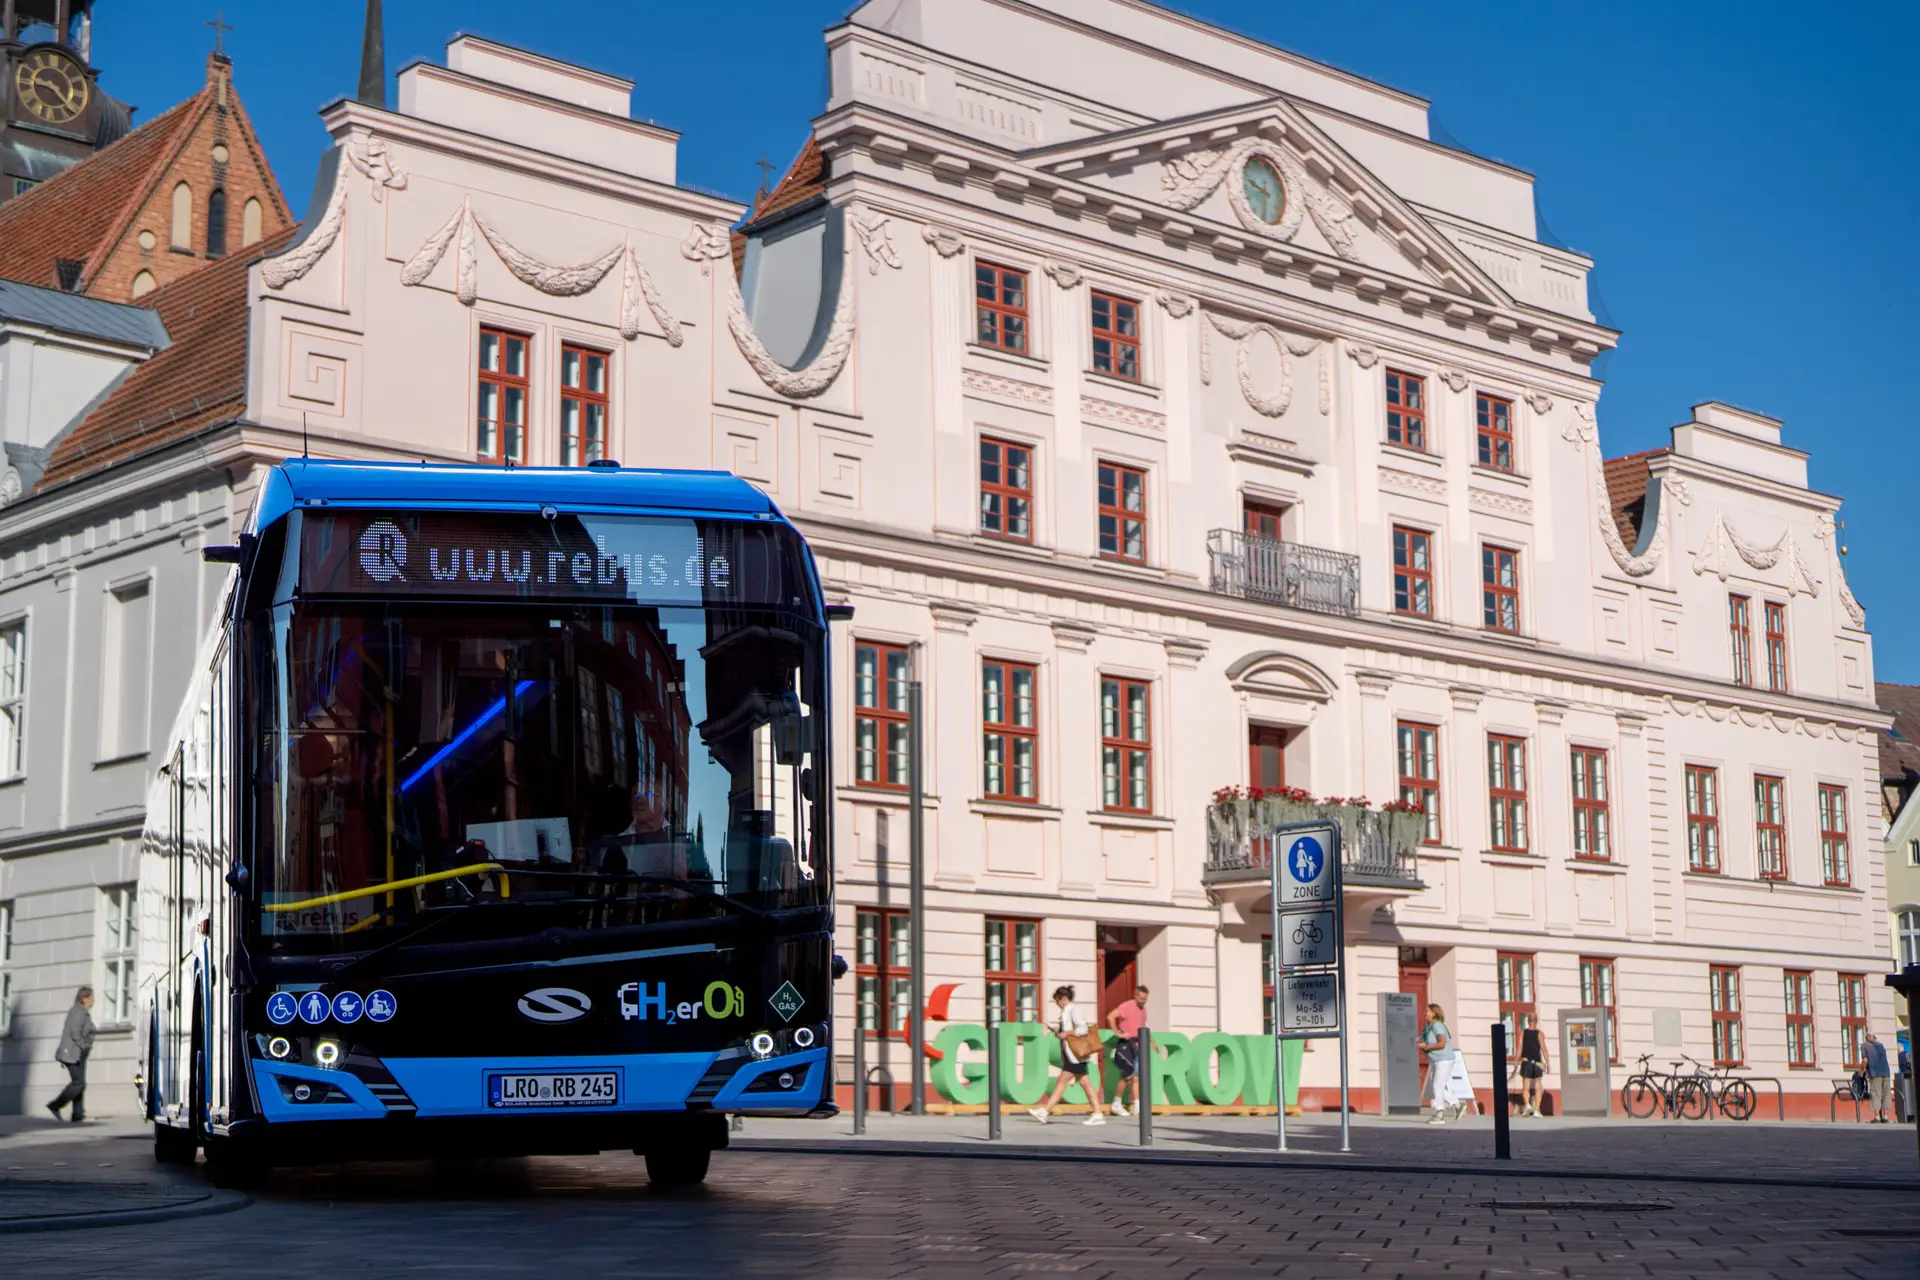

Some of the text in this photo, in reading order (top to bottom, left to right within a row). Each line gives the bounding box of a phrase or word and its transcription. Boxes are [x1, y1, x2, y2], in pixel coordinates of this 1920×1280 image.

[430, 535, 730, 587] www.rebus.de
[1293, 885, 1320, 898] ZONE
[1300, 948, 1317, 959] frei
[1302, 992, 1317, 1001] frei
[778, 1002, 796, 1010] GAS
[1296, 1003, 1324, 1013] Mo-Sa
[503, 1077, 614, 1098] LRO RB 245
